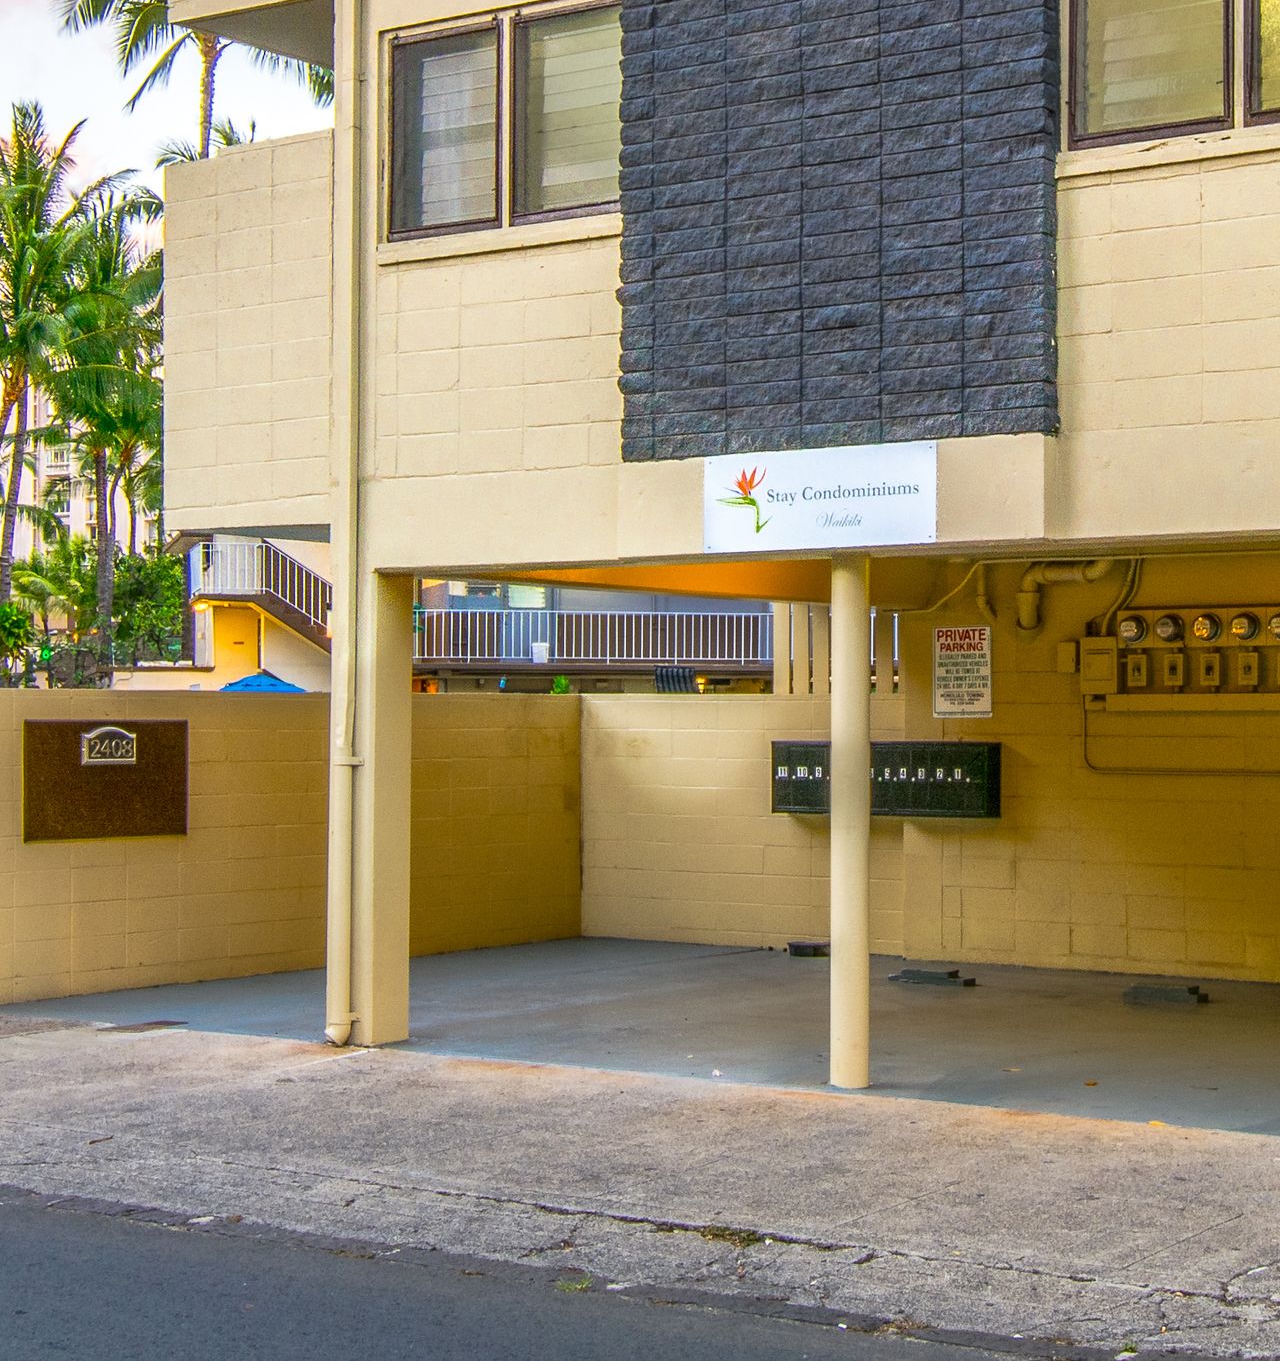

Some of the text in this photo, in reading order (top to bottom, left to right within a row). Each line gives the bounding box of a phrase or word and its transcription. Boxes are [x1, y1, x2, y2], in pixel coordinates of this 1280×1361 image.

[766, 482, 920, 507] Stay Condominiums
[816, 509, 863, 528] Waikiki
[936, 628, 986, 642] PRIVATE
[940, 642, 983, 652] PARKING
[90, 738, 133, 758] 2408
[798, 767, 807, 777] 10
[816, 767, 821, 777] 9
[900, 768, 906, 778] 4
[918, 768, 924, 779] 3
